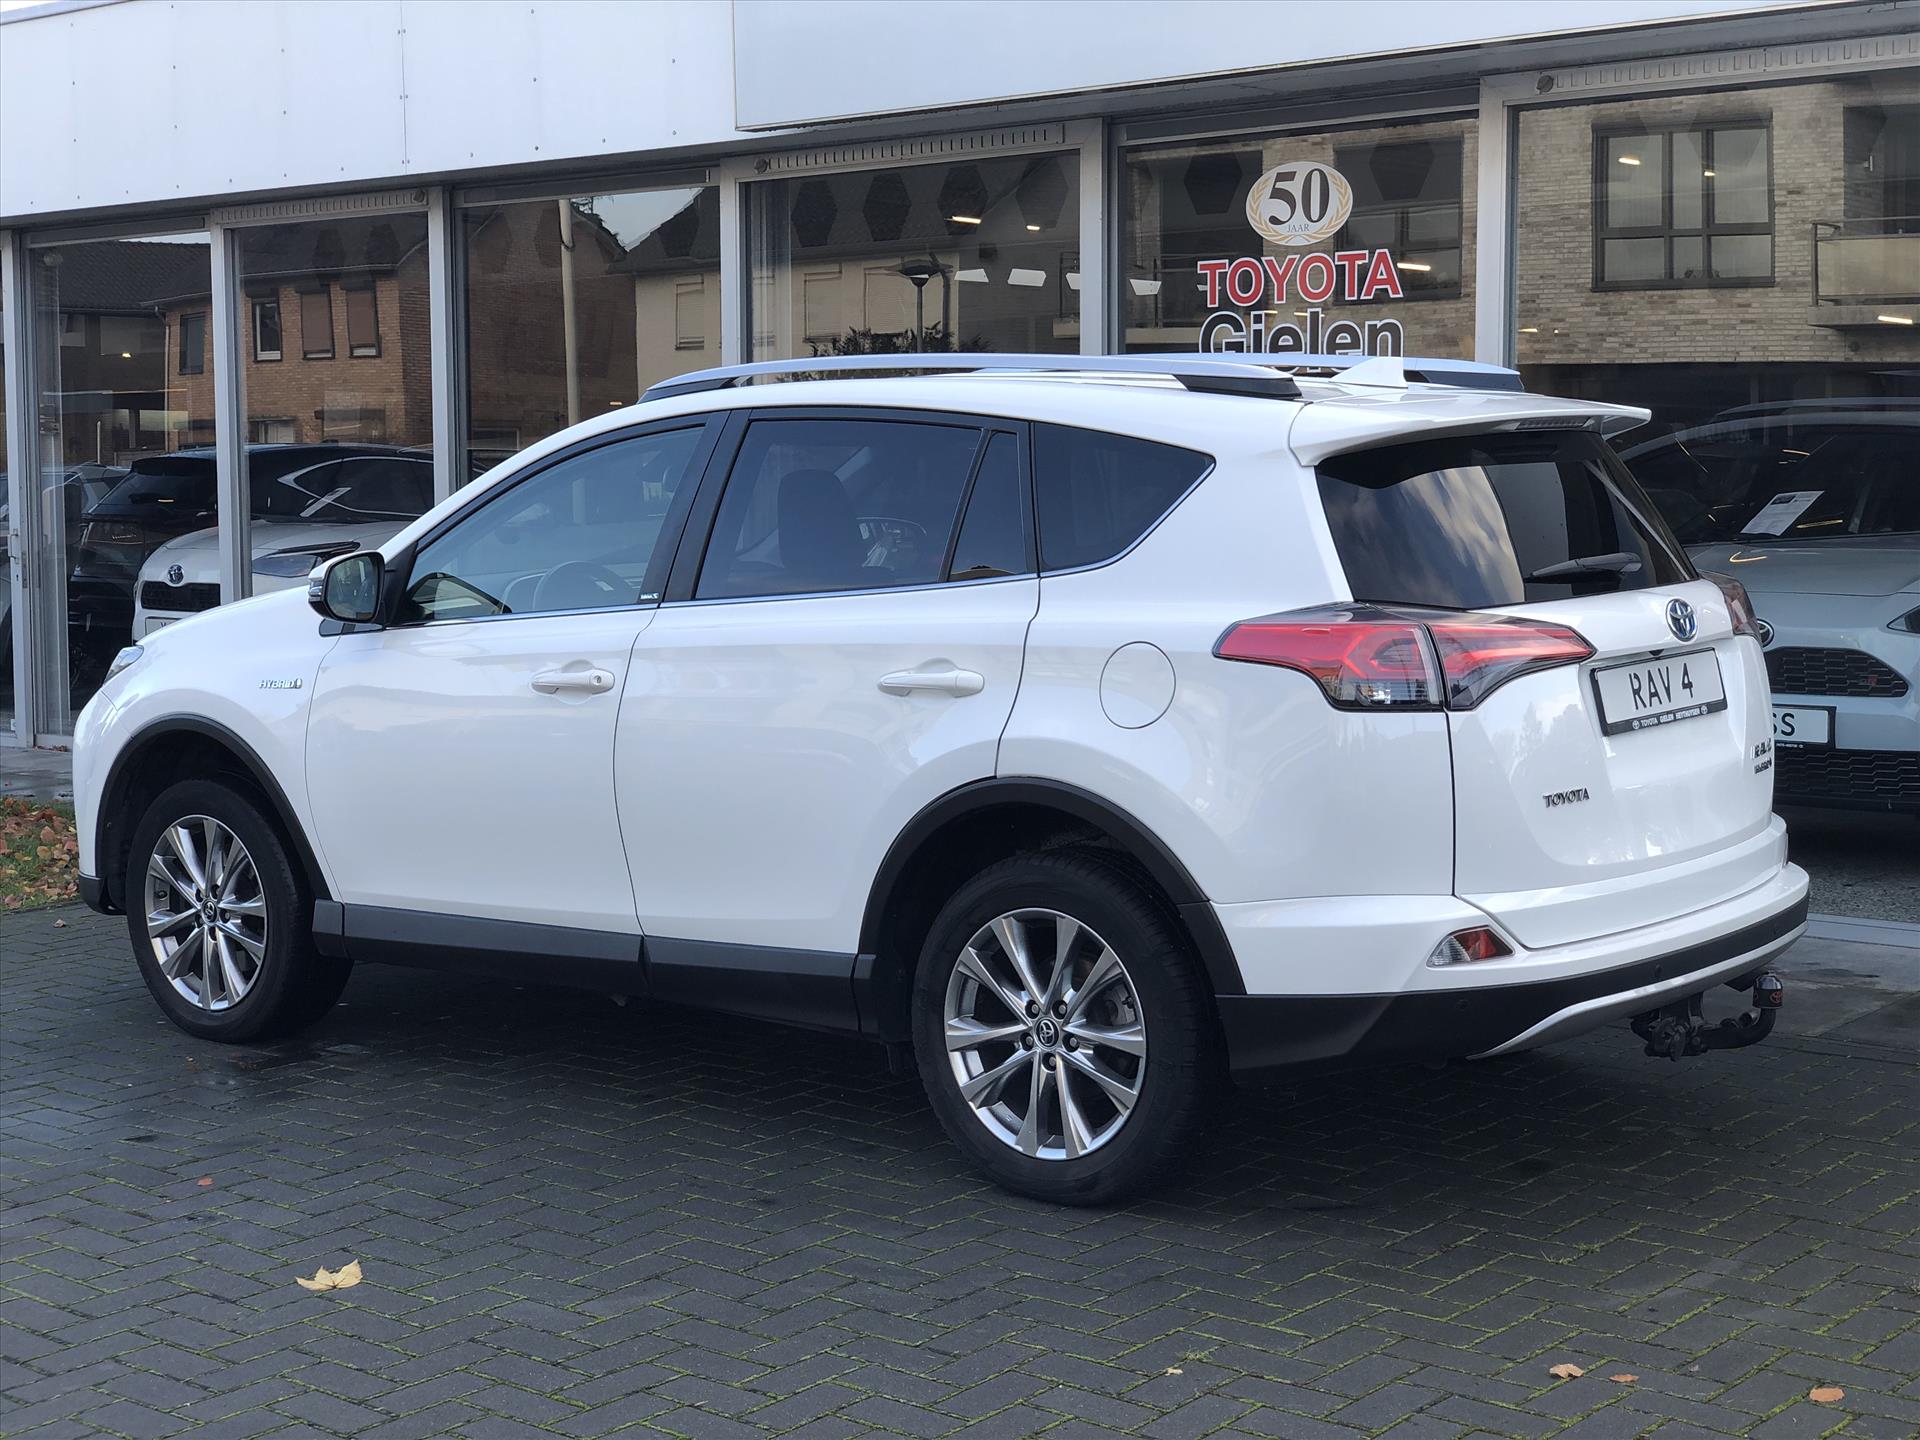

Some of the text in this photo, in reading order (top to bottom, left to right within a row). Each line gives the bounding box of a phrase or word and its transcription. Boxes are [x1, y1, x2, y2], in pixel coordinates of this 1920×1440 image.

[1268, 168, 1330, 226] 50
[1287, 224, 1310, 233] JAAR
[1197, 249, 1404, 308] TOYOTA
[1199, 308, 1404, 373] Gielen
[259, 679, 295, 689] HYBRID
[1628, 662, 1694, 711] RAV 4
[1542, 787, 1590, 809] TOYOTA
